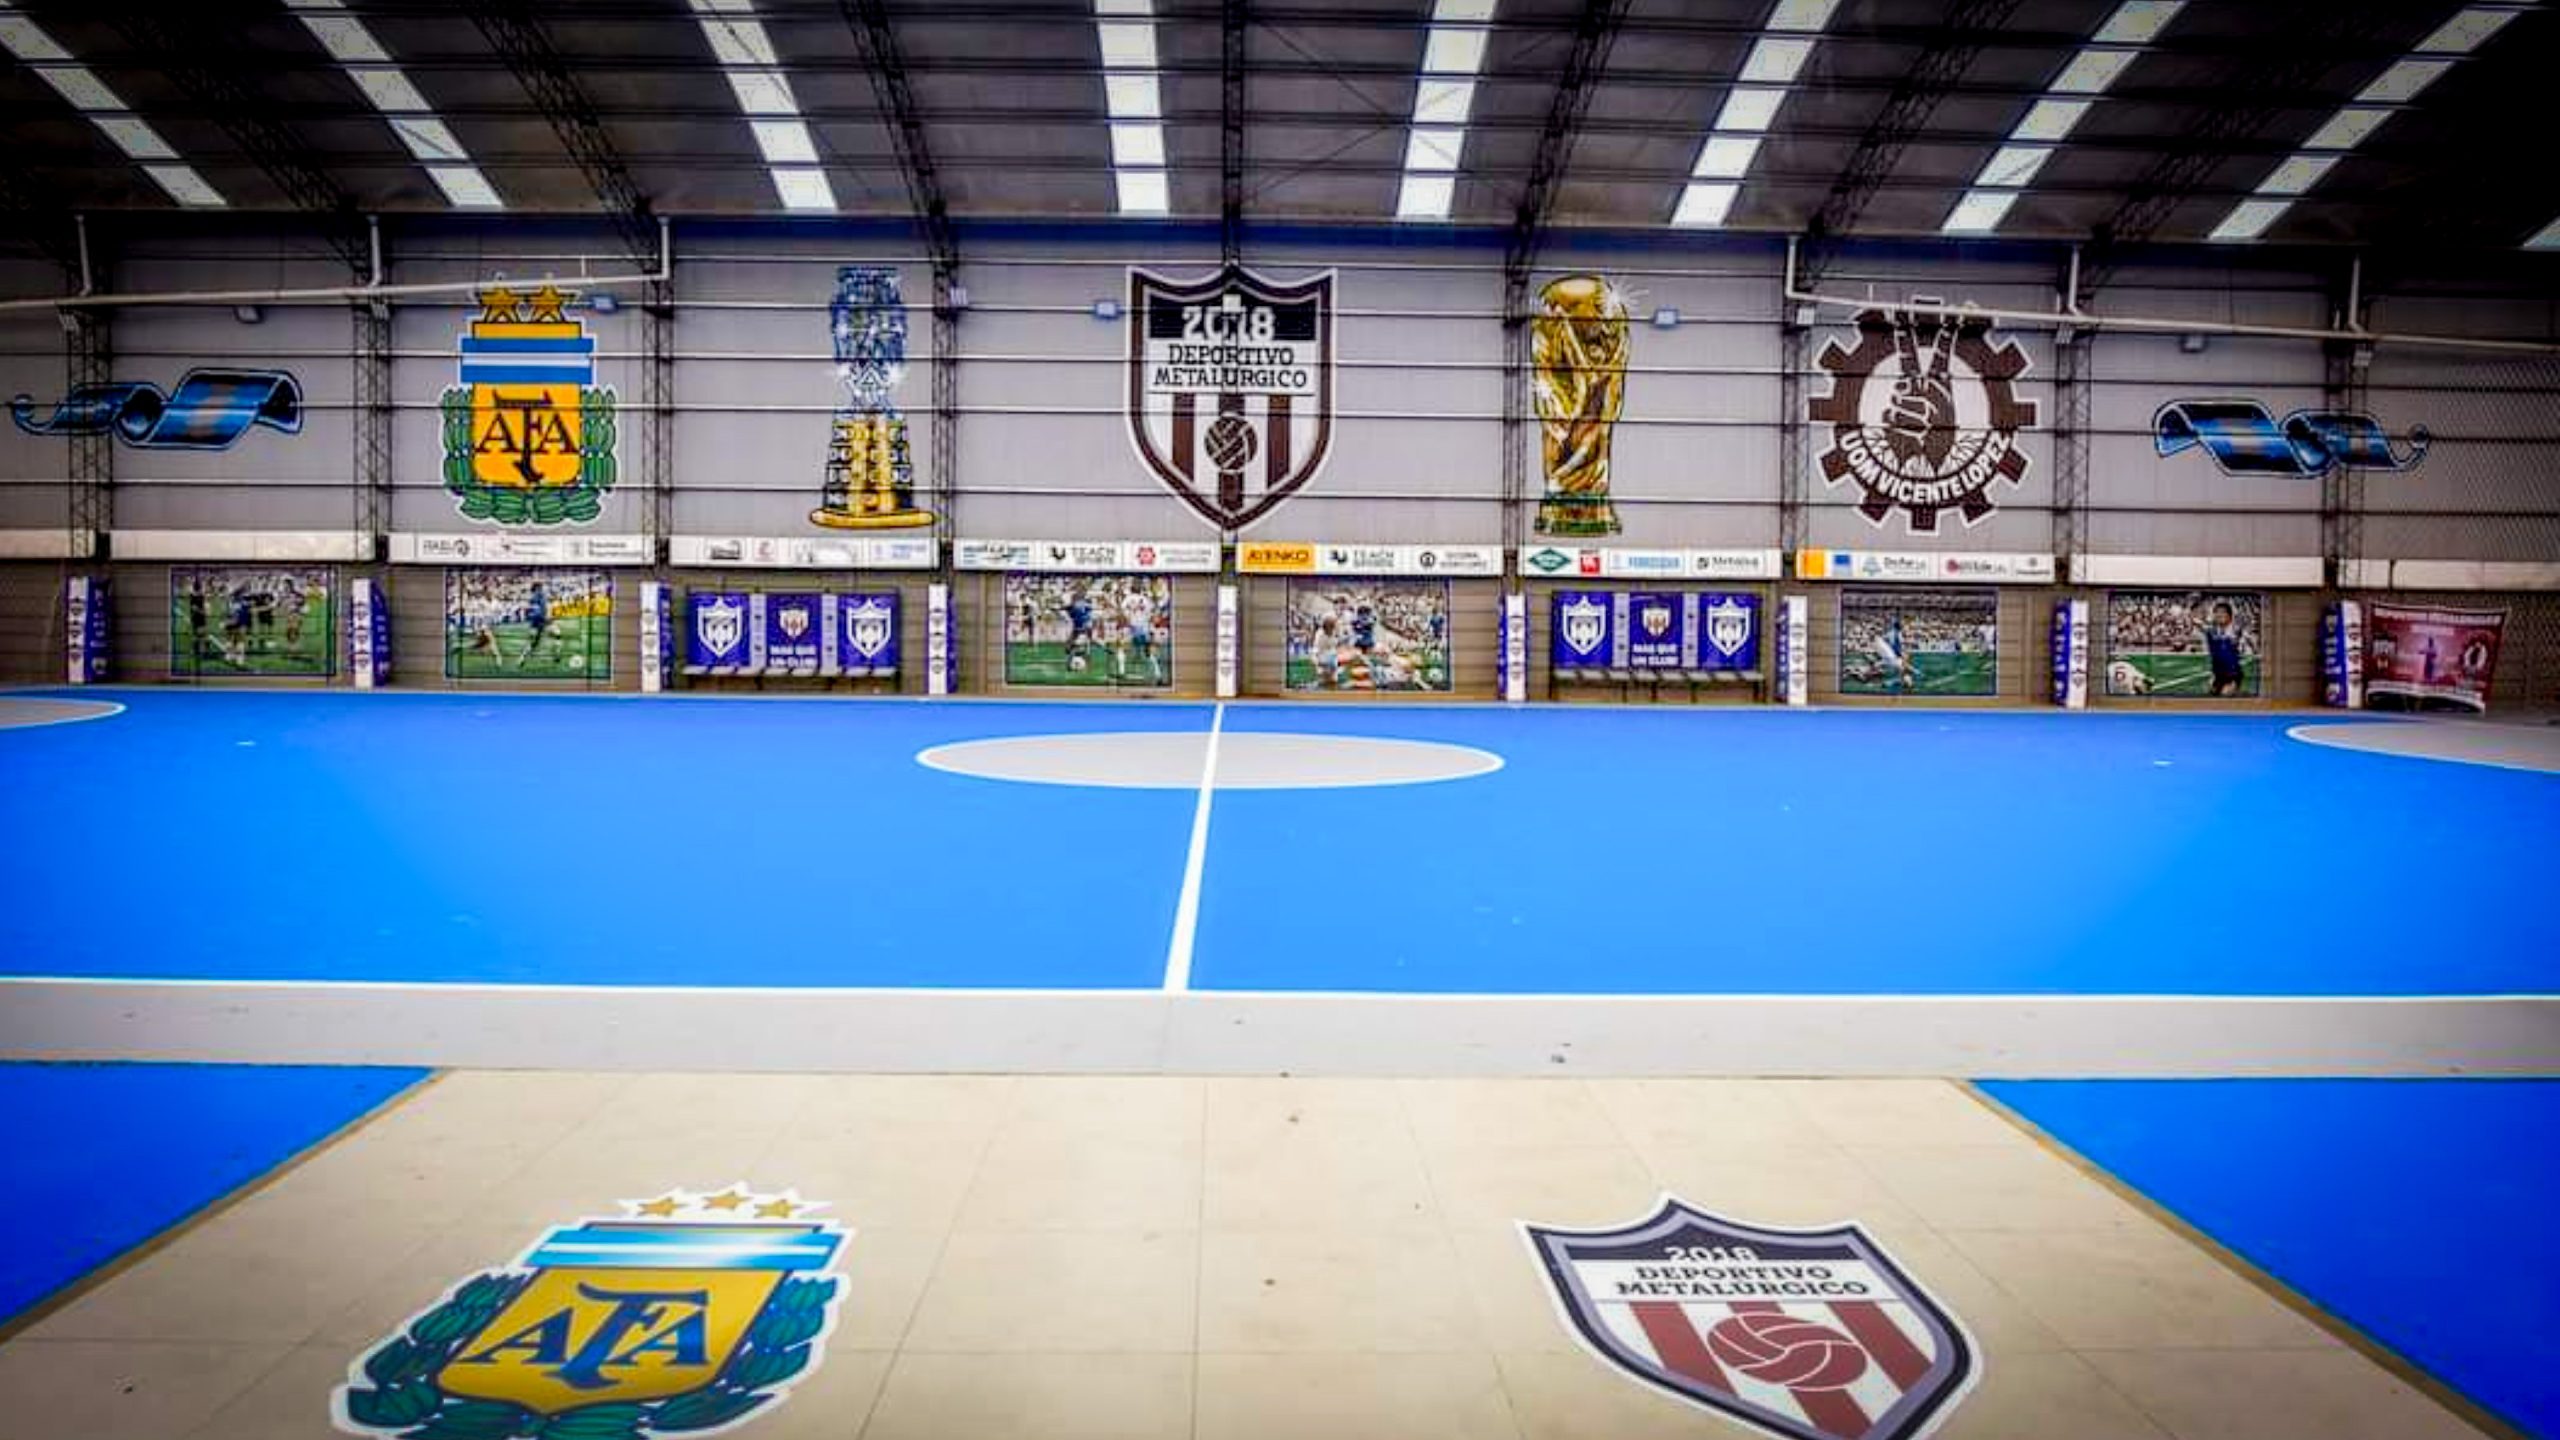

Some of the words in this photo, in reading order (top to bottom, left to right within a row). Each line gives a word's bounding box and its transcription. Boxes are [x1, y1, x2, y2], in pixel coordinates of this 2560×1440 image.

[1182, 305, 1276, 341] 2018
[1168, 344, 1294, 365] DEPORTIVO
[1154, 367, 1307, 388] METALURGICO
[474, 389, 580, 483] AFA
[1840, 430, 1876, 485] UOM
[1876, 478, 1963, 504] VICENTE
[1960, 430, 2011, 489] LOPEZ
[1635, 1266, 1833, 1281] DEPORTIVO
[1615, 1281, 1871, 1296] METALURGICO
[453, 1281, 710, 1391] AFA
